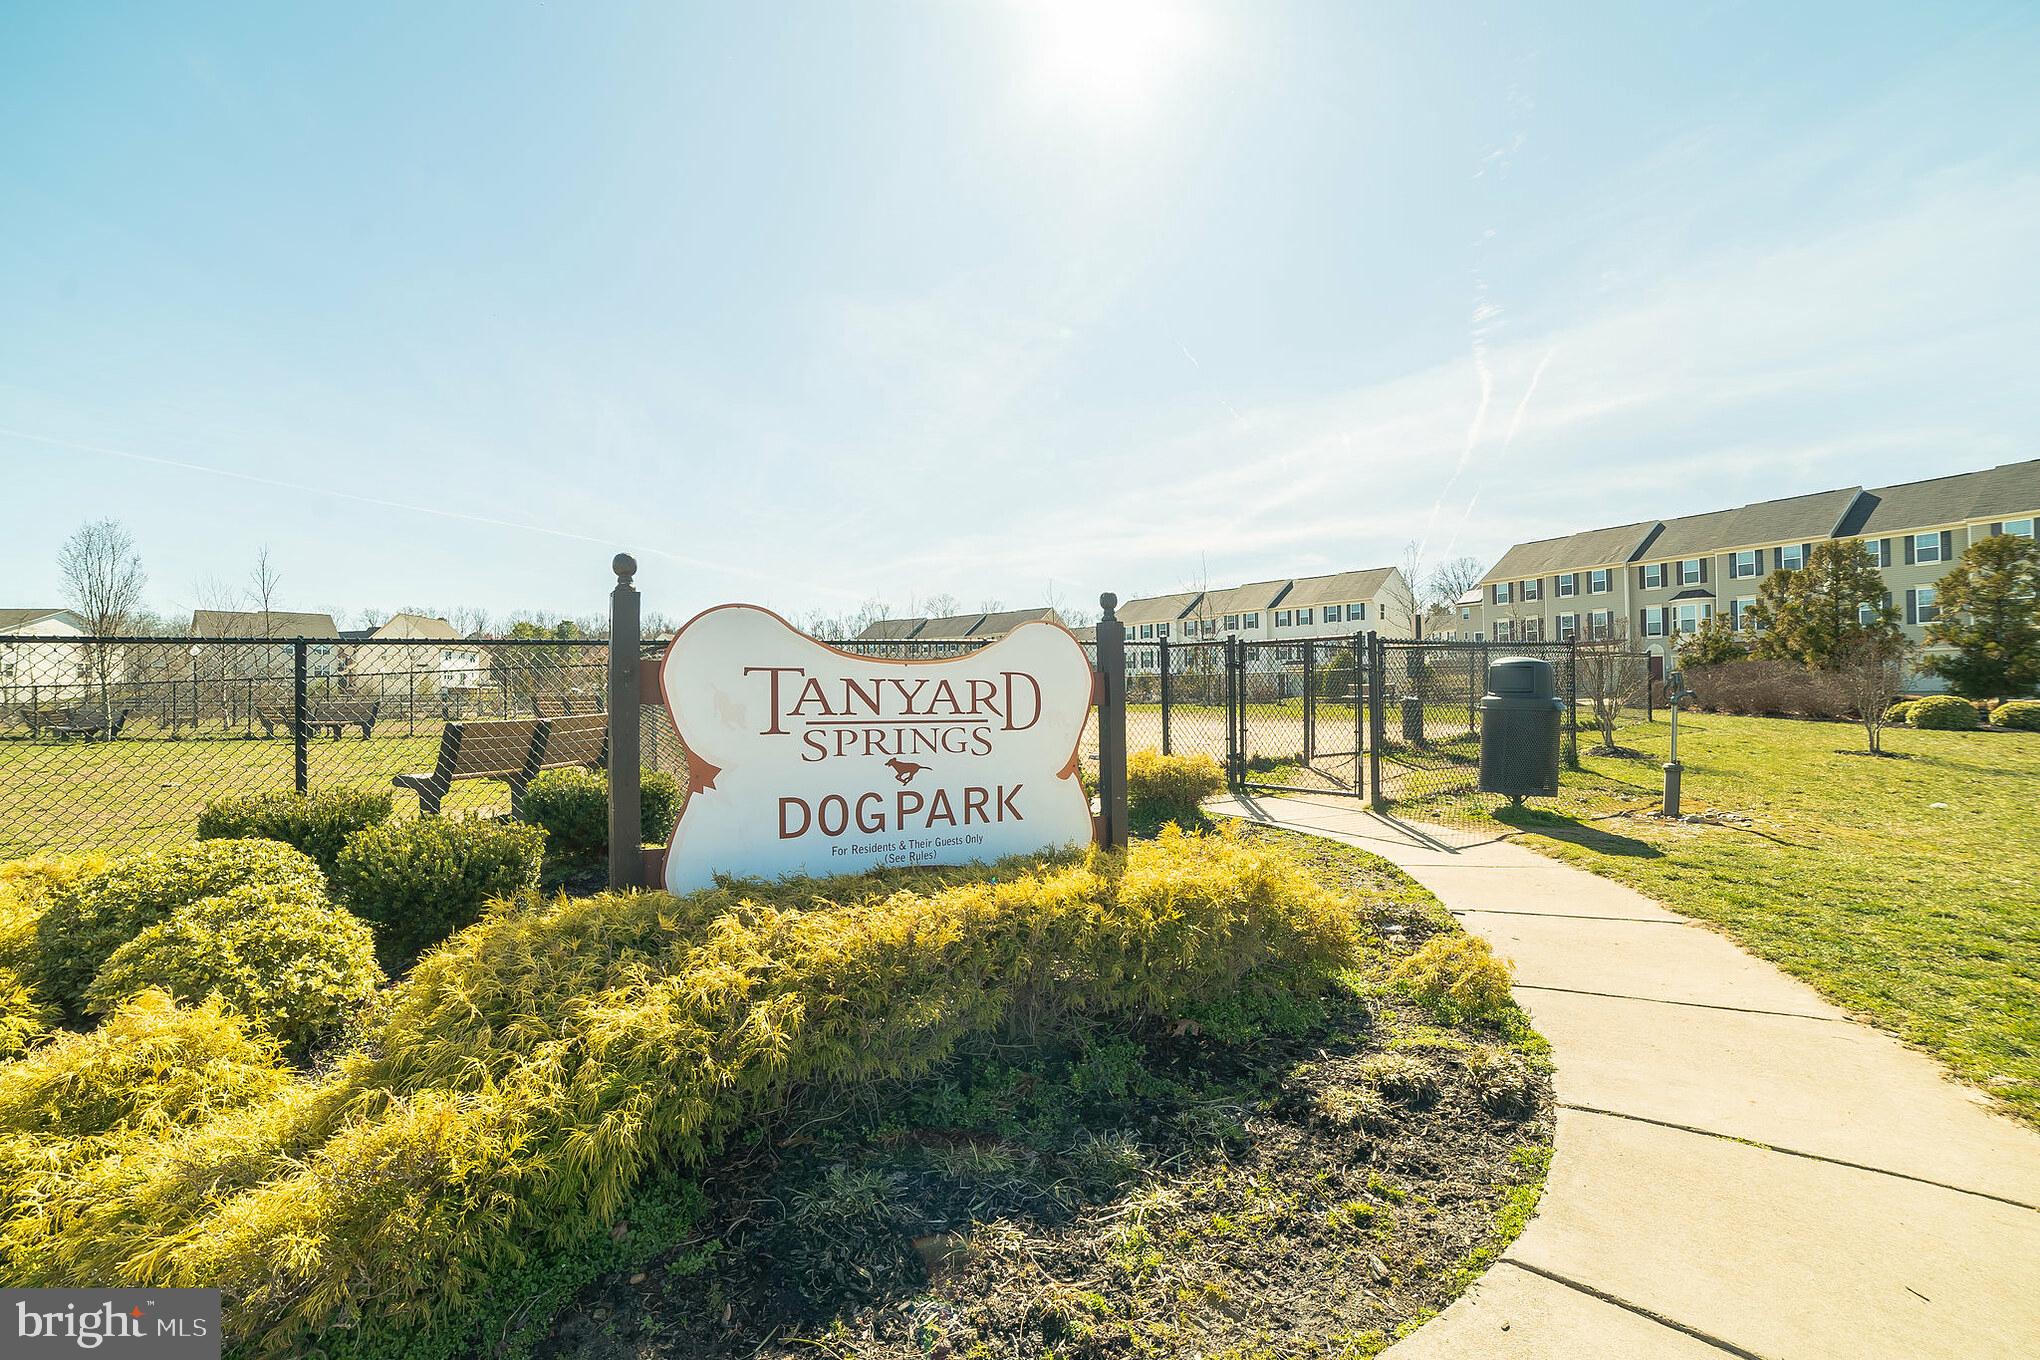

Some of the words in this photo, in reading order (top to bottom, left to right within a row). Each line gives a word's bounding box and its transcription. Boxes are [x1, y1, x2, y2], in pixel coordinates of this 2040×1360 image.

[743, 667, 1042, 736] TANYARD
[801, 726, 993, 762] SPRINGS
[831, 845, 848, 857] For
[851, 843, 897, 856] Residents
[898, 840, 907, 851] &
[909, 838, 933, 850] Their
[935, 835, 963, 848] Guests
[965, 833, 984, 845] Only
[884, 853, 906, 865] (See
[909, 850, 938, 863] Rules)
